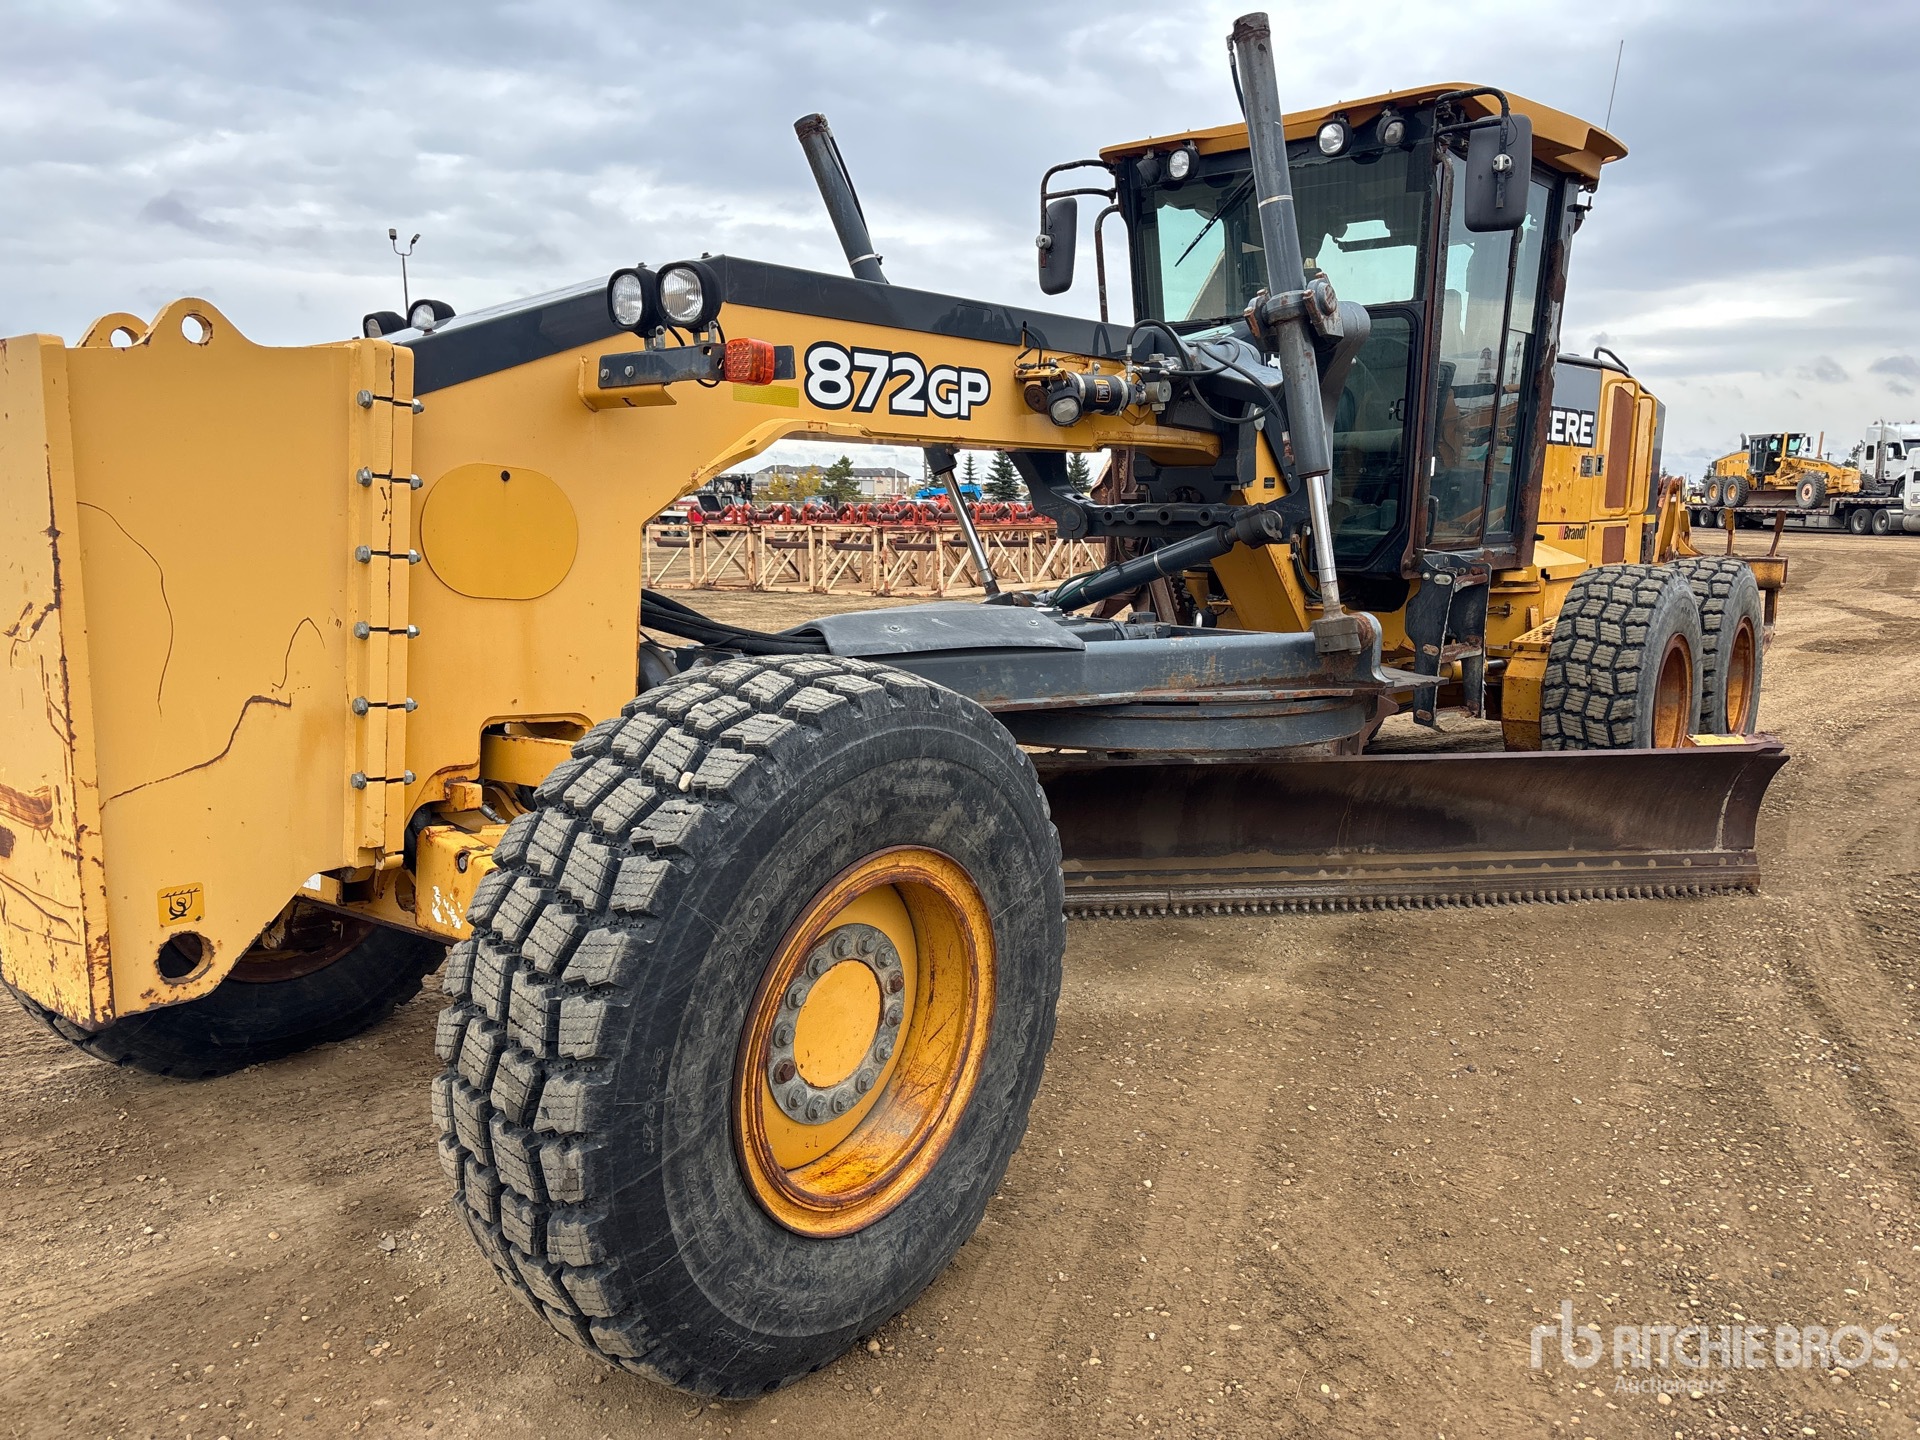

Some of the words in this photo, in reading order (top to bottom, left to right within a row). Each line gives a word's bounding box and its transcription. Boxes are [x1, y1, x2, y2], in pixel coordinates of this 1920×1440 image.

[804, 341, 991, 420] 872GP
[1547, 406, 1595, 447] ERE
[1563, 525, 1587, 540] Brandt
